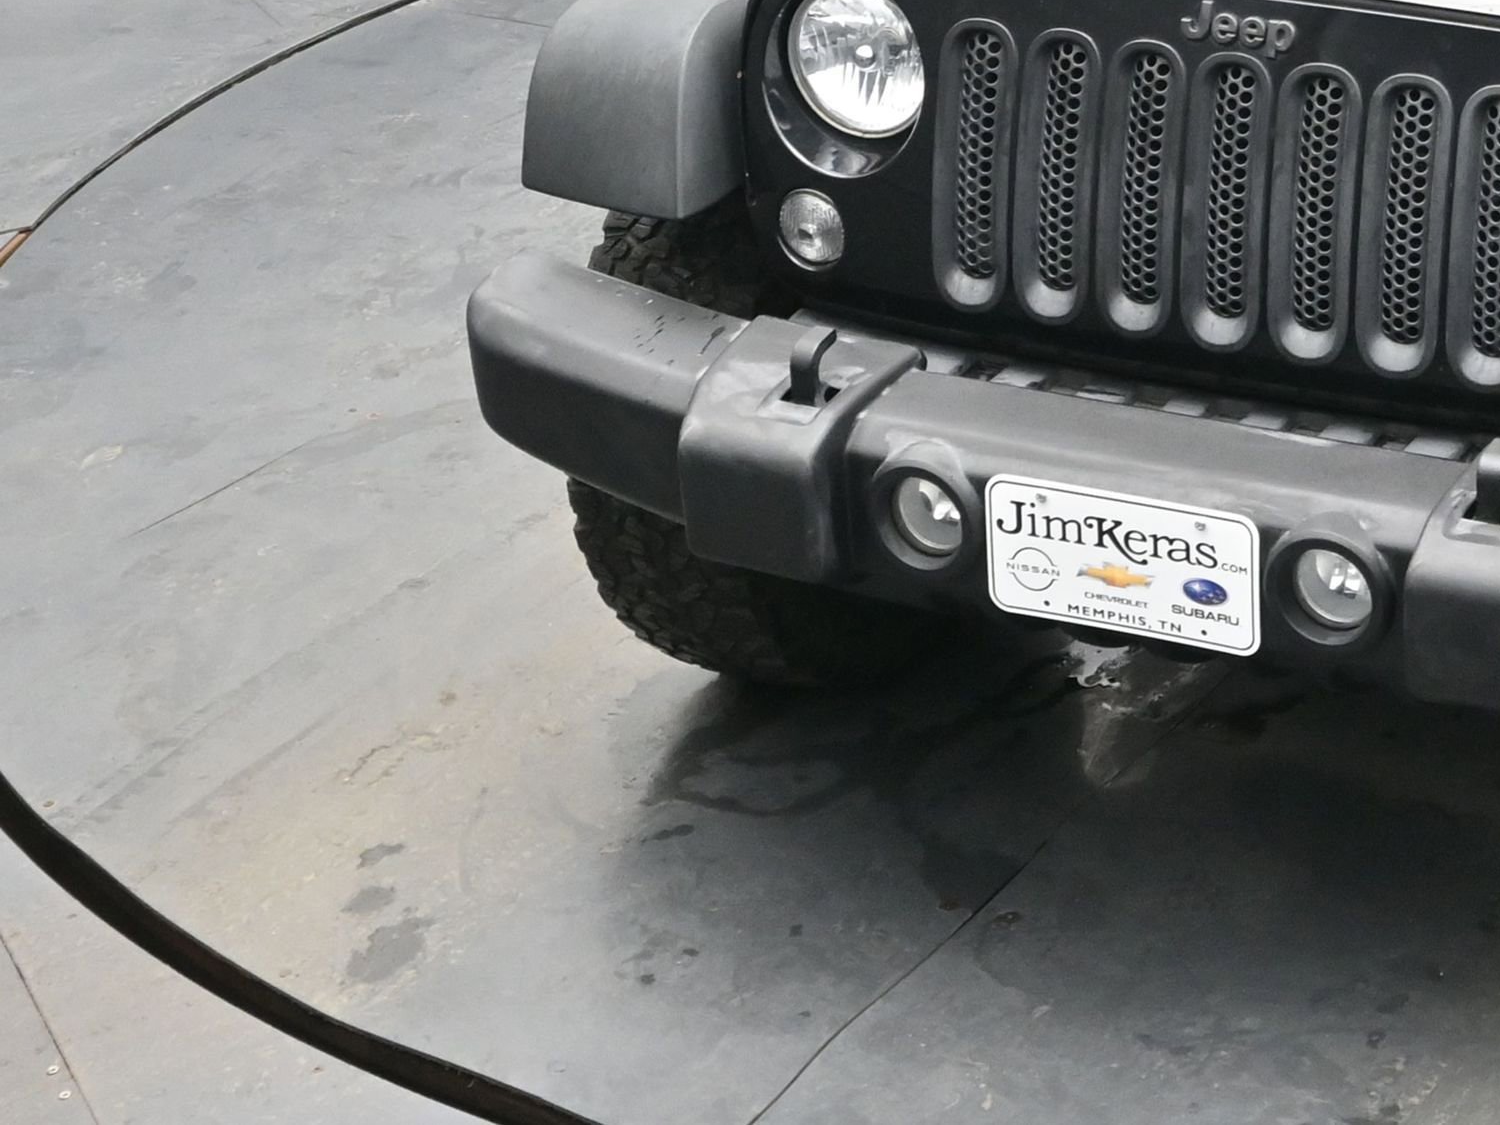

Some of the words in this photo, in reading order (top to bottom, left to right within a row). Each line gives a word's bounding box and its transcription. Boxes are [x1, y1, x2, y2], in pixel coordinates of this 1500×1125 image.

[1180, 0, 1296, 59] Jeep
[1006, 562, 1061, 577] NISSAN
[1084, 591, 1149, 610] CHEVROLET
[1067, 603, 1152, 630] MEMPHIS,
[1158, 620, 1183, 633] TN
[1171, 604, 1240, 627] SUBARU
